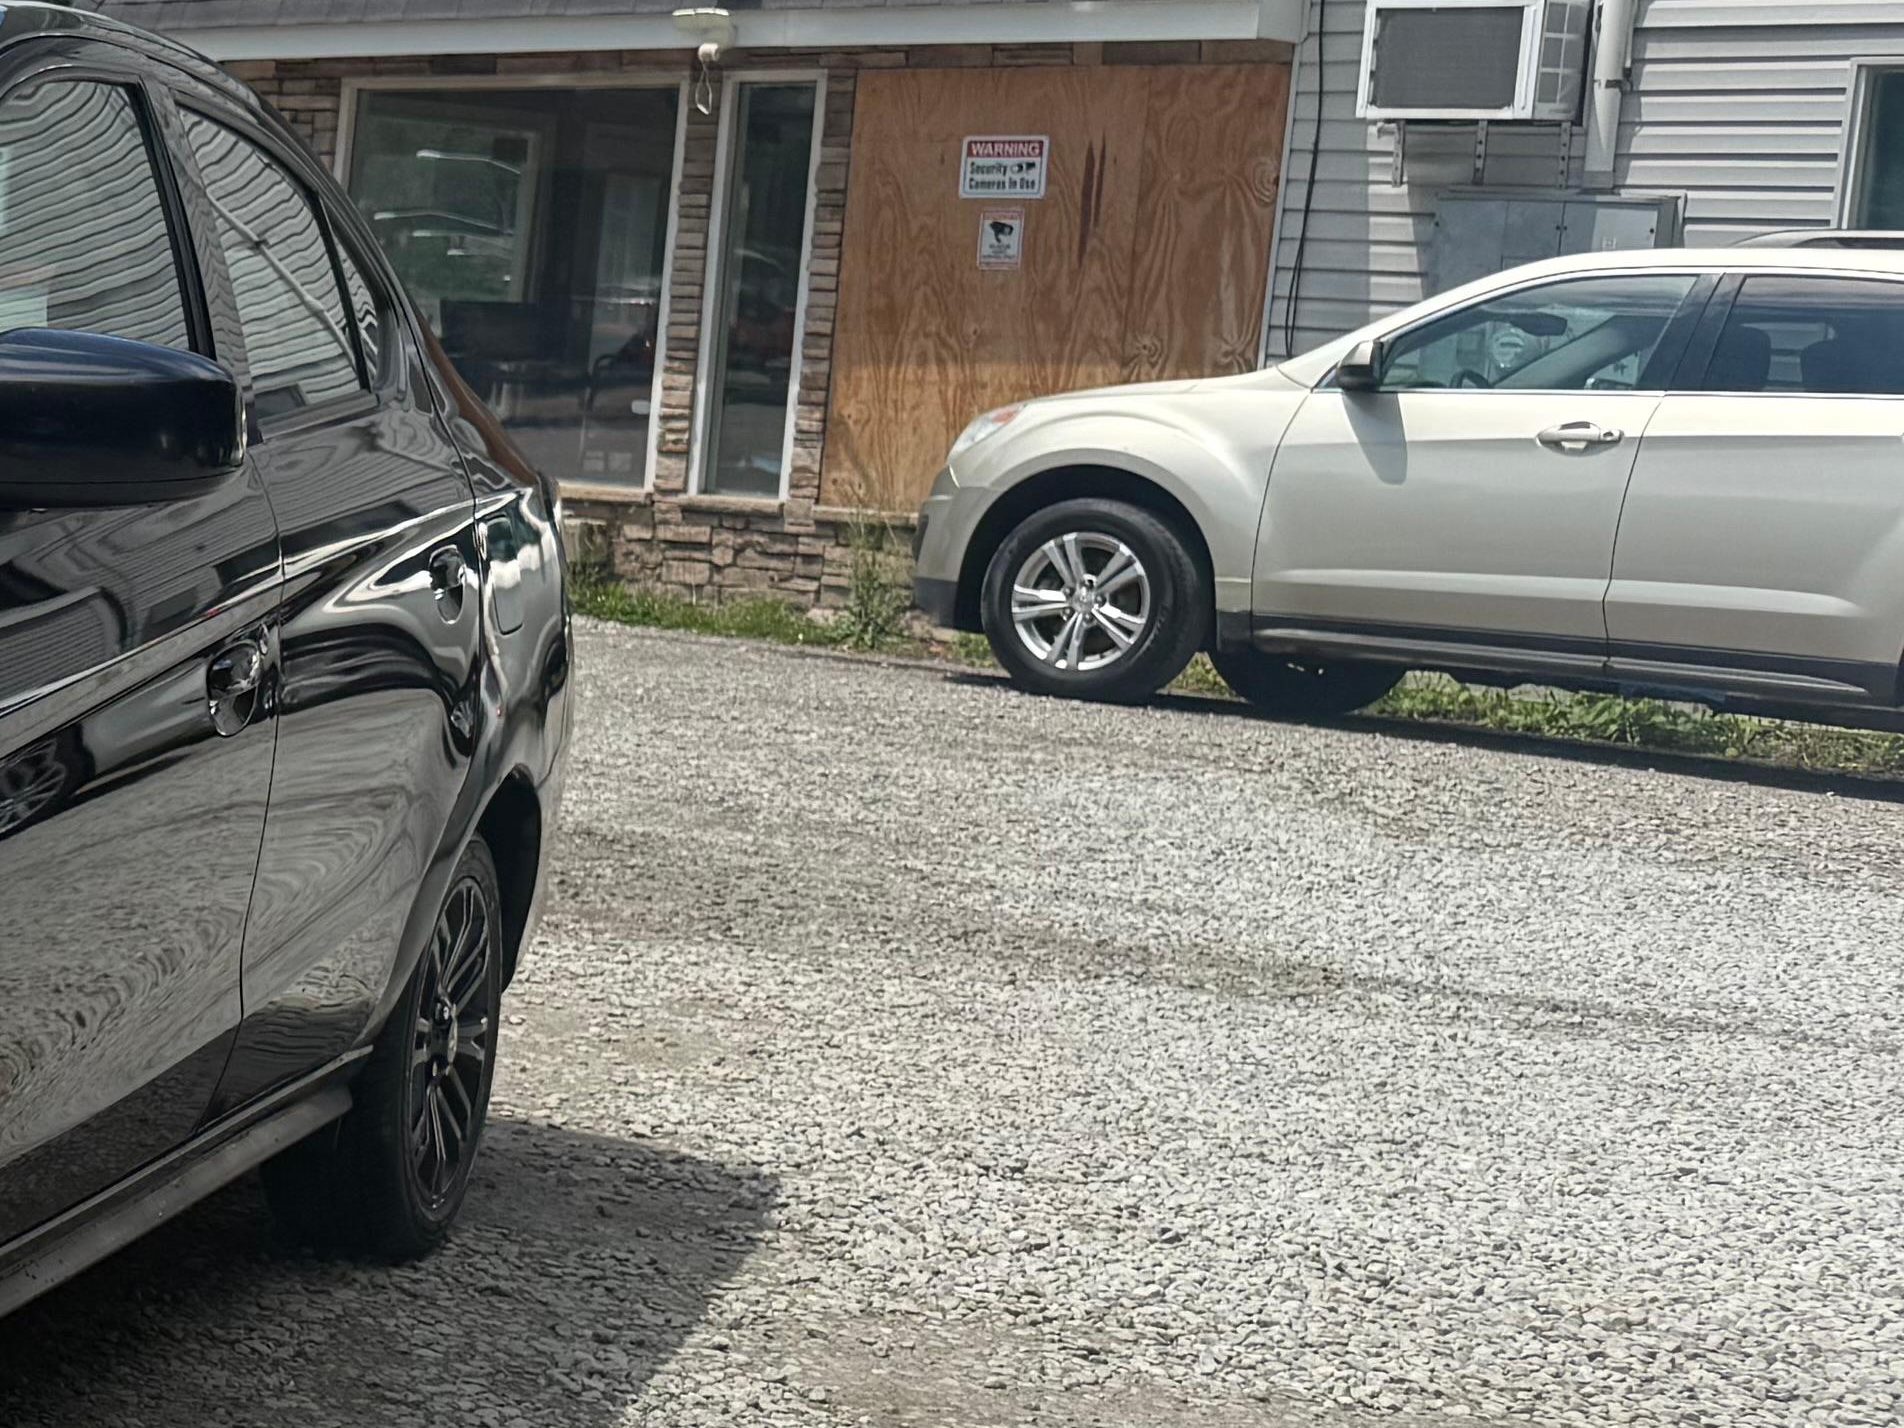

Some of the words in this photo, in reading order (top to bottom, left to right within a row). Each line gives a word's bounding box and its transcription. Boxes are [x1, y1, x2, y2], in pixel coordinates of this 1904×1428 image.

[971, 142, 1040, 157] WARNING
[970, 162, 1007, 177] Security
[969, 178, 1006, 190] Cameras
[1020, 177, 1035, 190] Use
